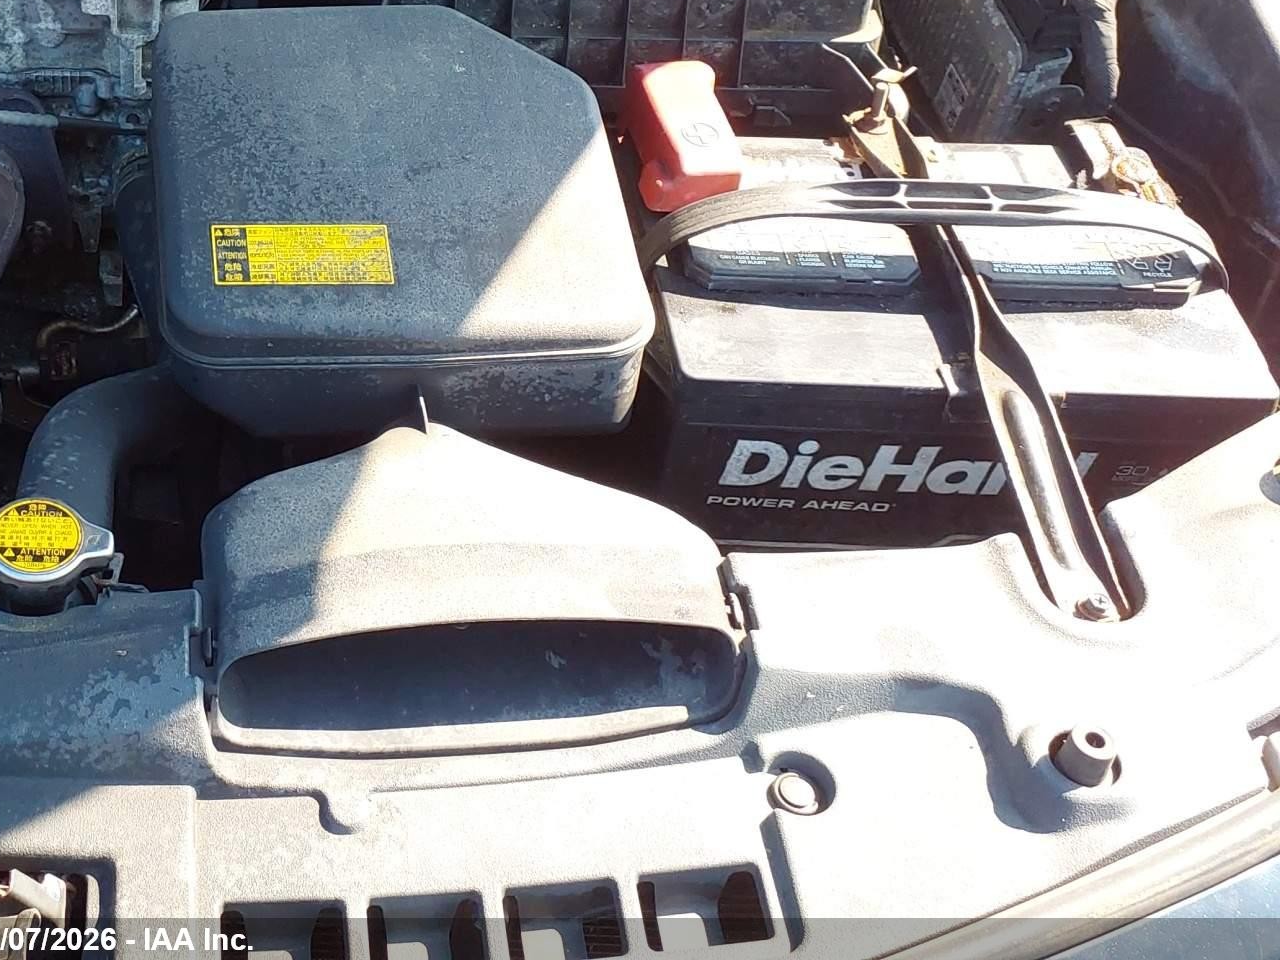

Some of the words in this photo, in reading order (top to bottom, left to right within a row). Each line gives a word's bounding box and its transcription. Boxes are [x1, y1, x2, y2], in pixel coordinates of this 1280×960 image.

[217, 239, 246, 247] CAUTION
[218, 252, 247, 260] ATTENTION
[707, 495, 800, 510] POWER
[802, 499, 891, 514] AHEAD
[20, 548, 66, 556] ATTENTION
